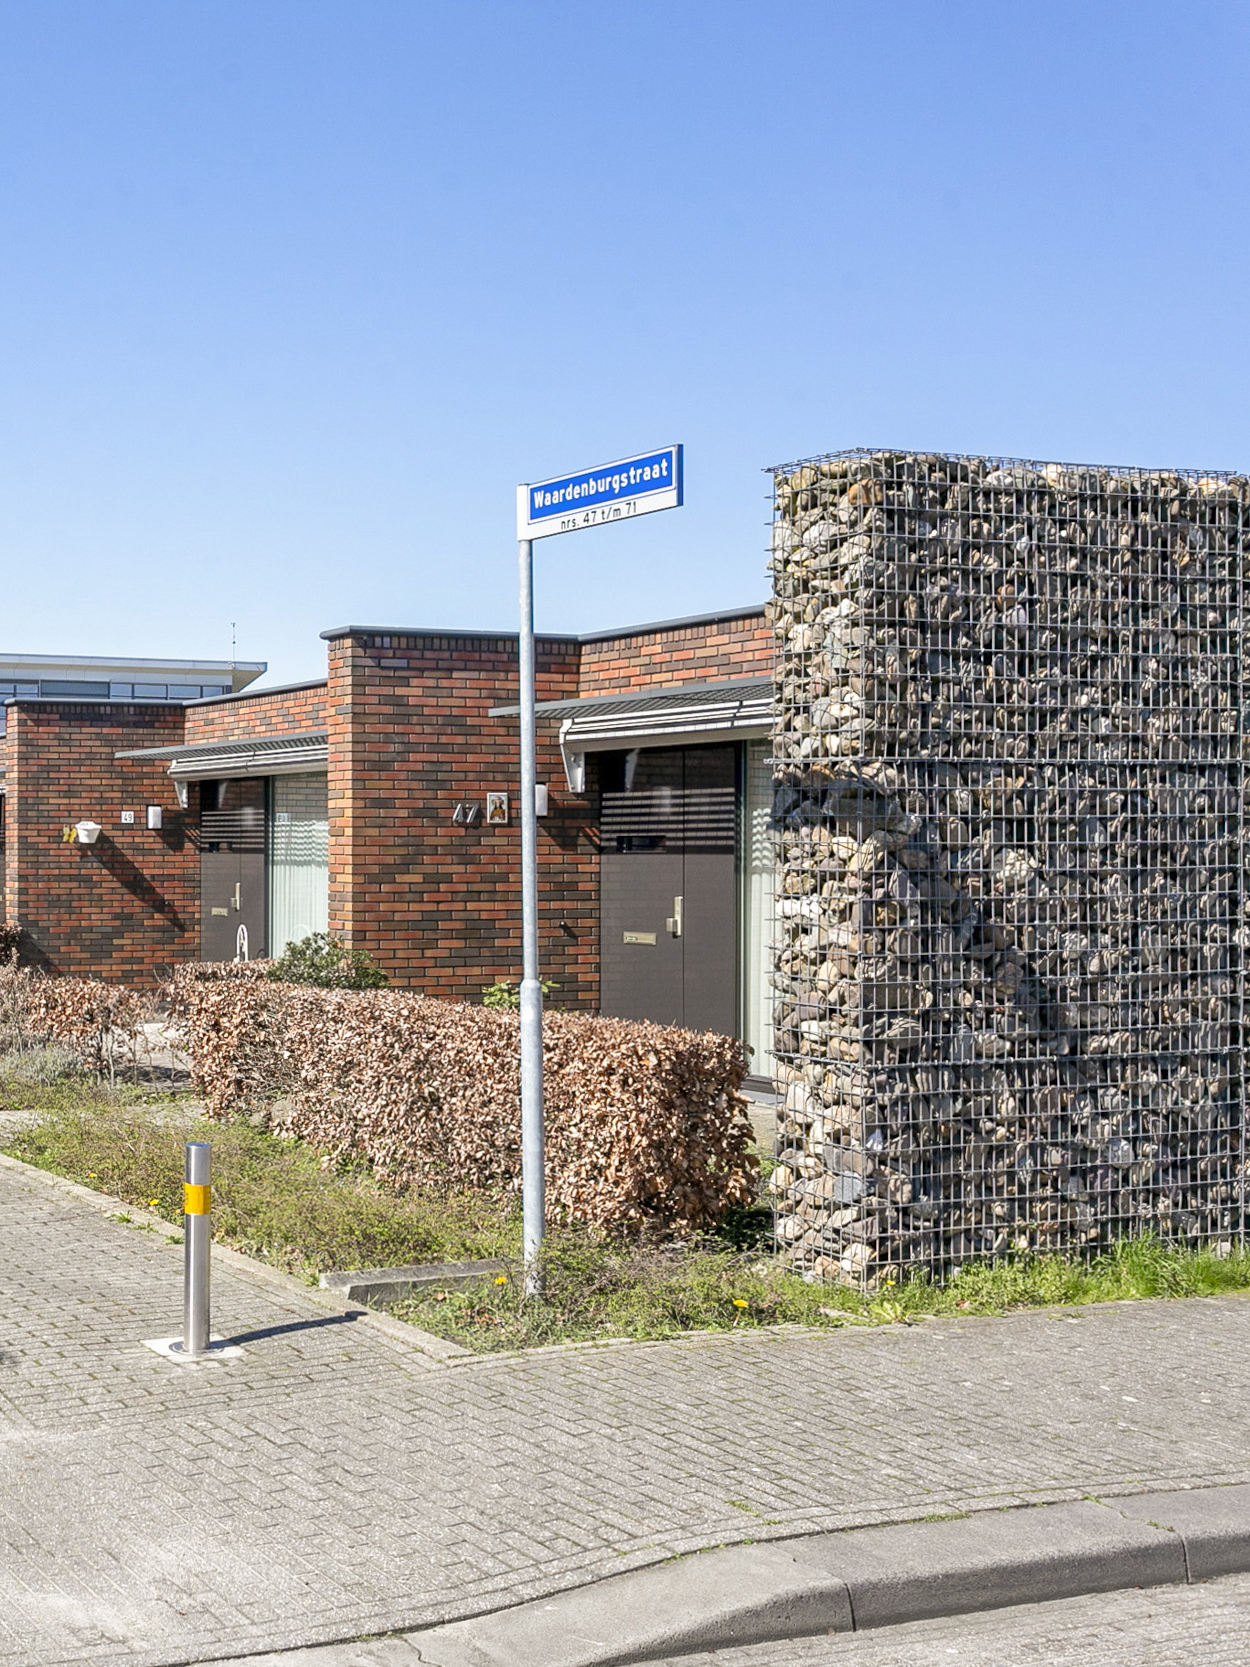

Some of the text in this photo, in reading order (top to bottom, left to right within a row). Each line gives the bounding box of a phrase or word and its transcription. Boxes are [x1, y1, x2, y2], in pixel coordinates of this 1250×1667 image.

[534, 458, 668, 509] Waardenburgstraat
[561, 501, 637, 530] nrs. 47 t/m 71
[124, 813, 133, 822] 49
[453, 804, 479, 823] 47
